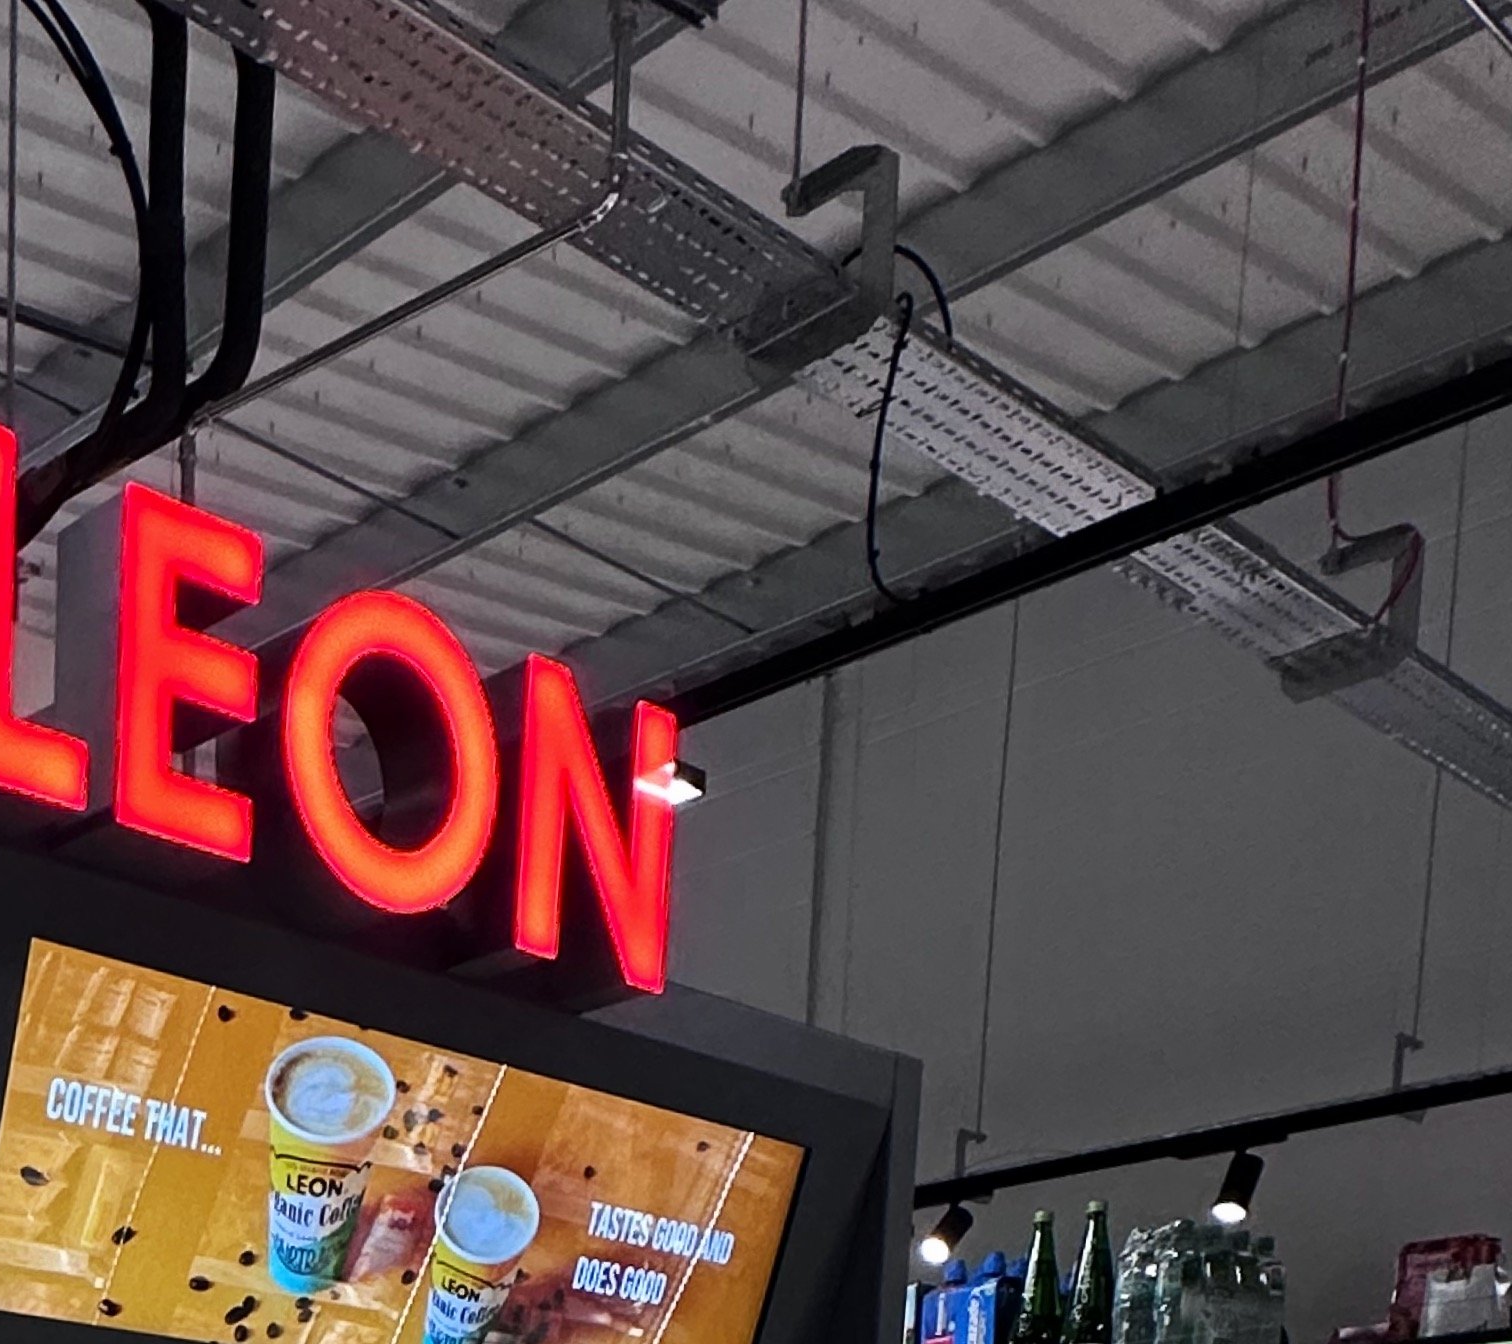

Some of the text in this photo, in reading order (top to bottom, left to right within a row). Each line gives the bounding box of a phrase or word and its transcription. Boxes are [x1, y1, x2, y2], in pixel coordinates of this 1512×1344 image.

[45, 1077, 142, 1138] COFFEE
[286, 1173, 344, 1199] LEON
[587, 1200, 735, 1266] TASTES GOOD AND
[572, 1255, 669, 1306] DOES GOOD
